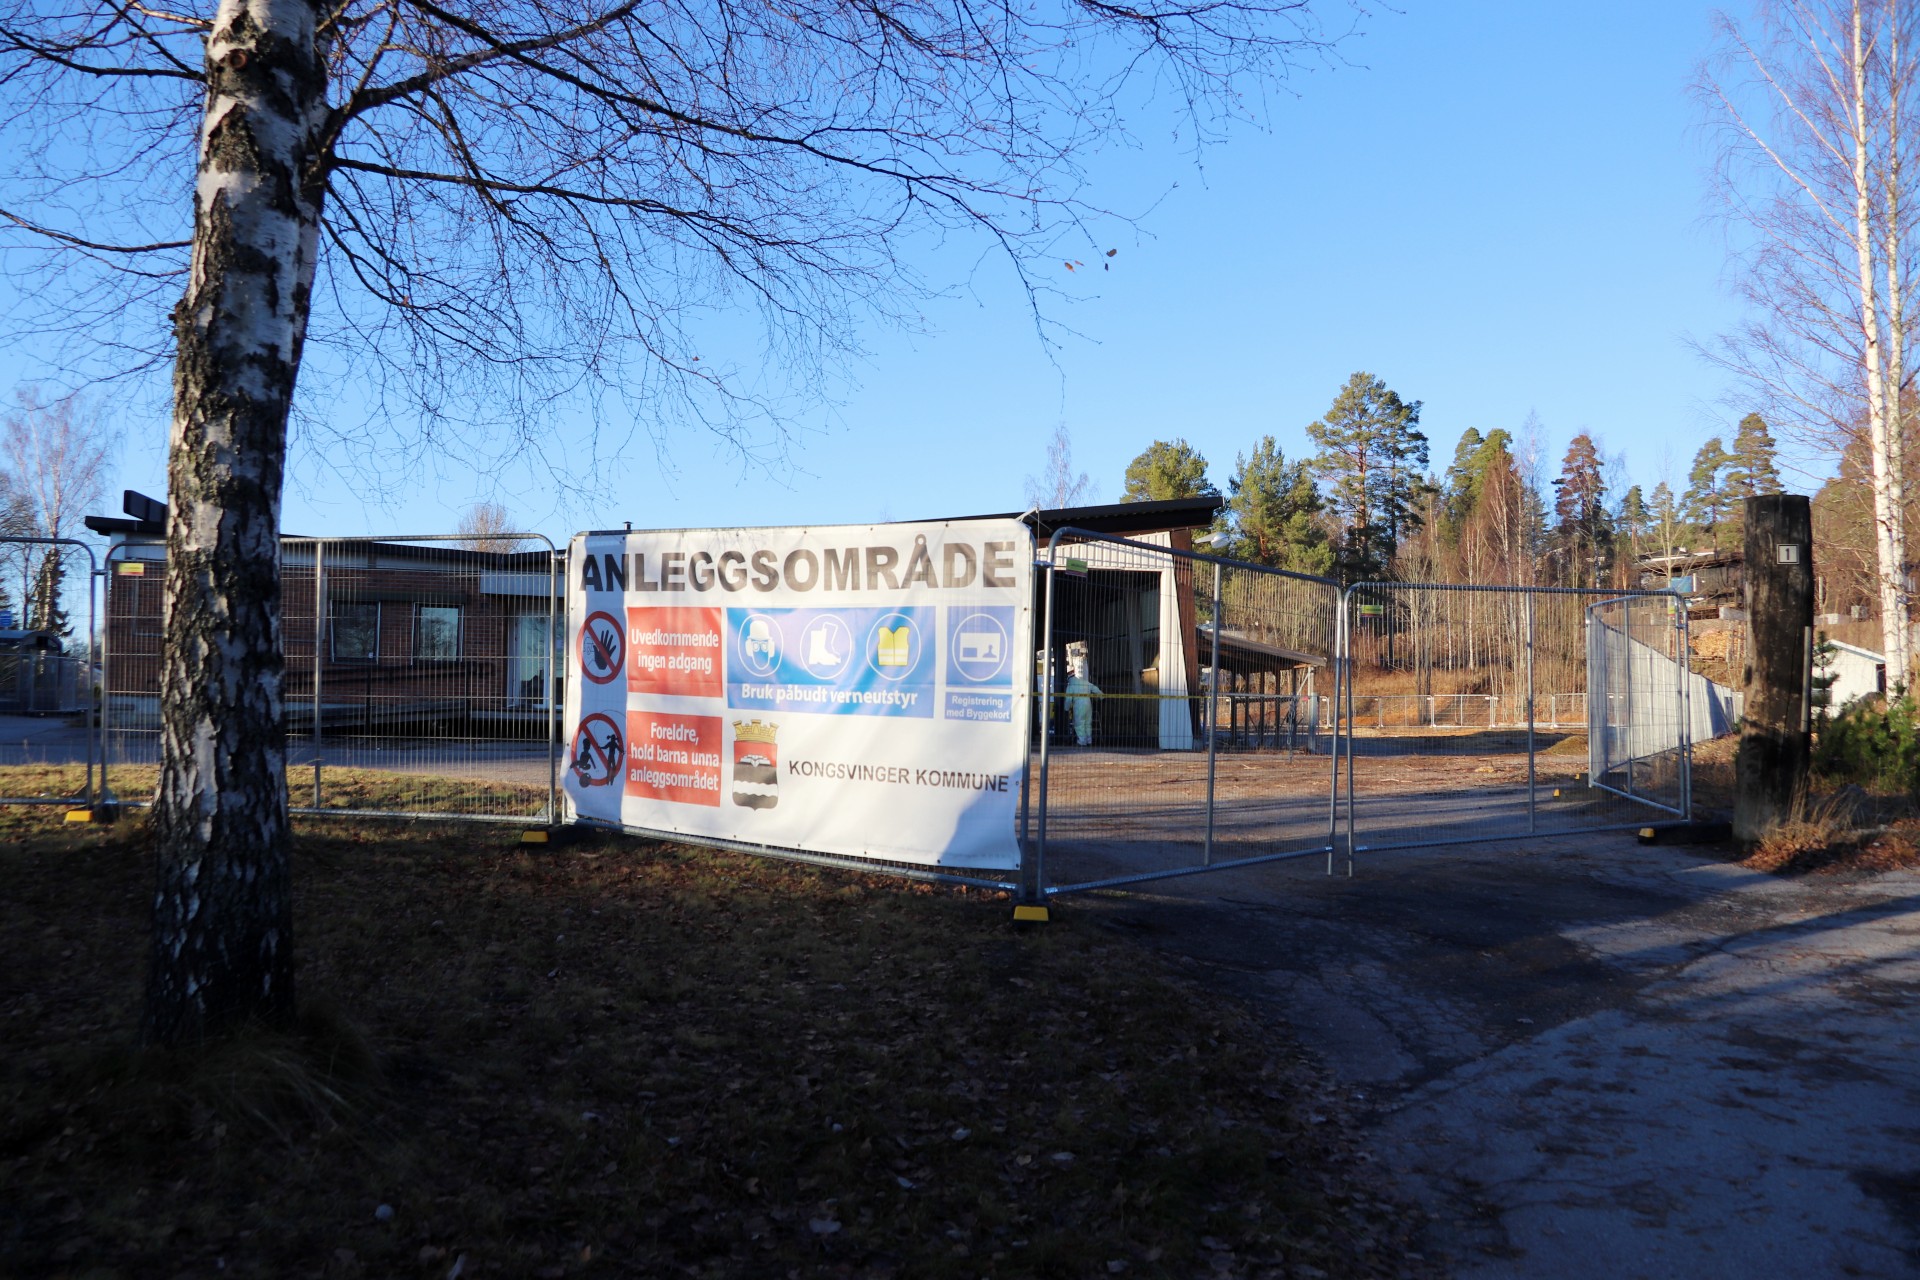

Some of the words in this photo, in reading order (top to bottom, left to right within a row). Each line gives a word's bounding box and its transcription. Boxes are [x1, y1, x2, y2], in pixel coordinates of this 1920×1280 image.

[579, 534, 1016, 592] ANLEGGSOMRÅDE
[1785, 548, 1790, 560] 1
[631, 628, 719, 648] Uvedkommende
[638, 651, 666, 672] ingen
[668, 652, 712, 674] adgang
[741, 684, 773, 700] Bruk
[776, 685, 828, 704] påbudt
[830, 690, 918, 706] verneutstyr
[952, 695, 1004, 709] Registrering
[946, 709, 964, 718] med
[966, 709, 1010, 721] Byggekort
[650, 722, 699, 744] Foreldre,
[630, 743, 654, 760] hold
[657, 745, 688, 764] barna
[691, 752, 720, 767] unna
[630, 767, 719, 791] anleggsområdet
[789, 760, 910, 784] KONGSVINGER
[916, 769, 1010, 793] KOMMUNE
